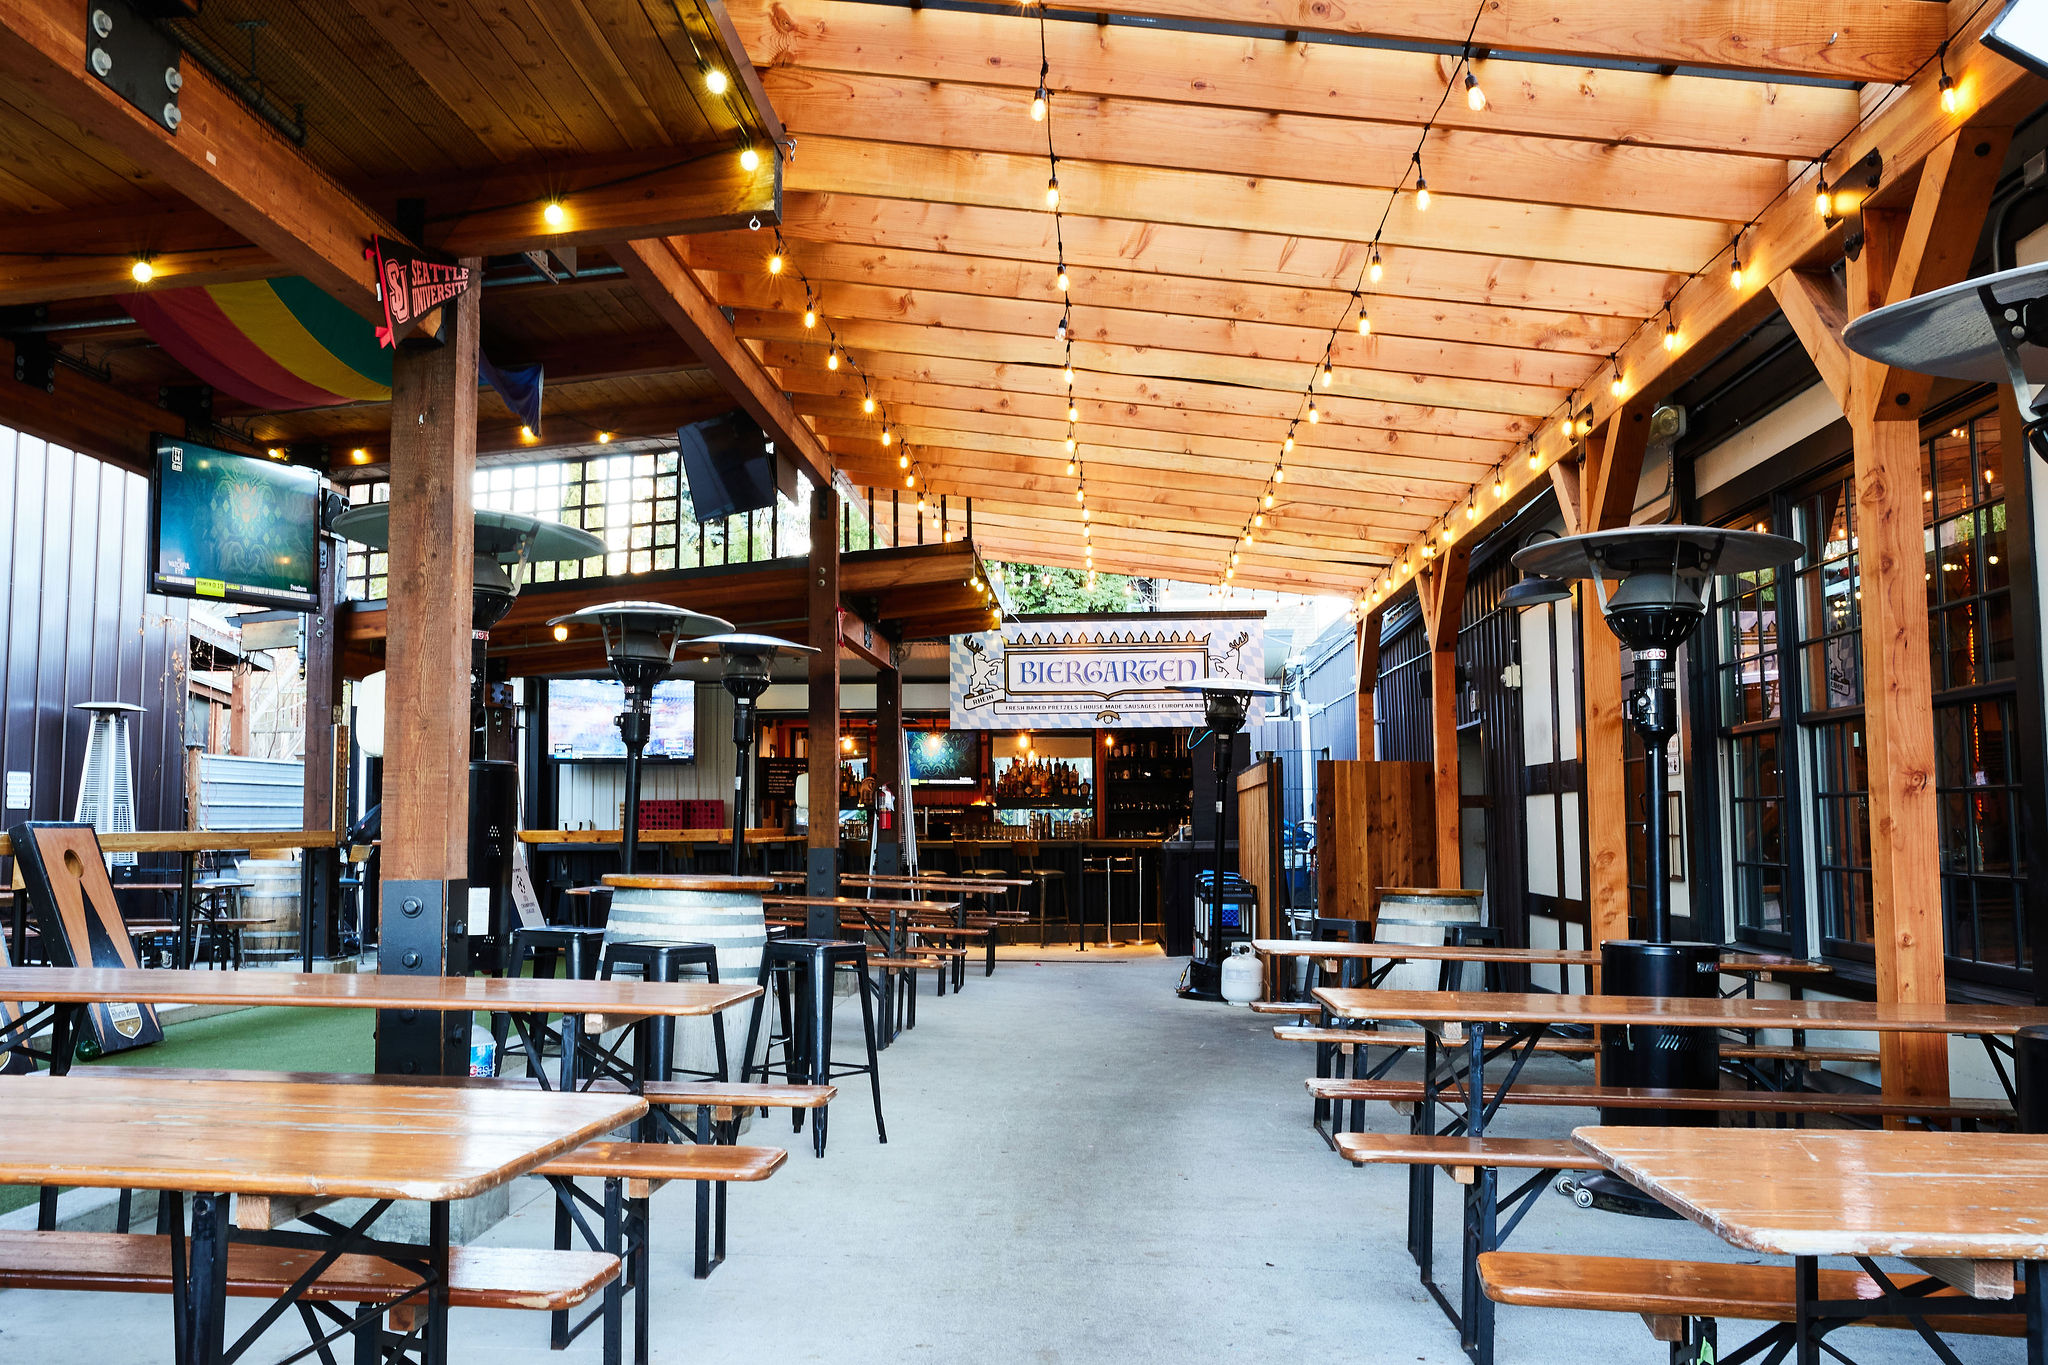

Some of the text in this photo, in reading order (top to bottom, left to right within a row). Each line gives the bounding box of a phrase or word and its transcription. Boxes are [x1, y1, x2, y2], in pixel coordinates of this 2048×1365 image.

[411, 259, 469, 286] SEATTLE
[411, 280, 468, 318] UNIVERSITY
[1017, 657, 1197, 686] BIERGARTEN
[972, 693, 995, 706] RHEIN
